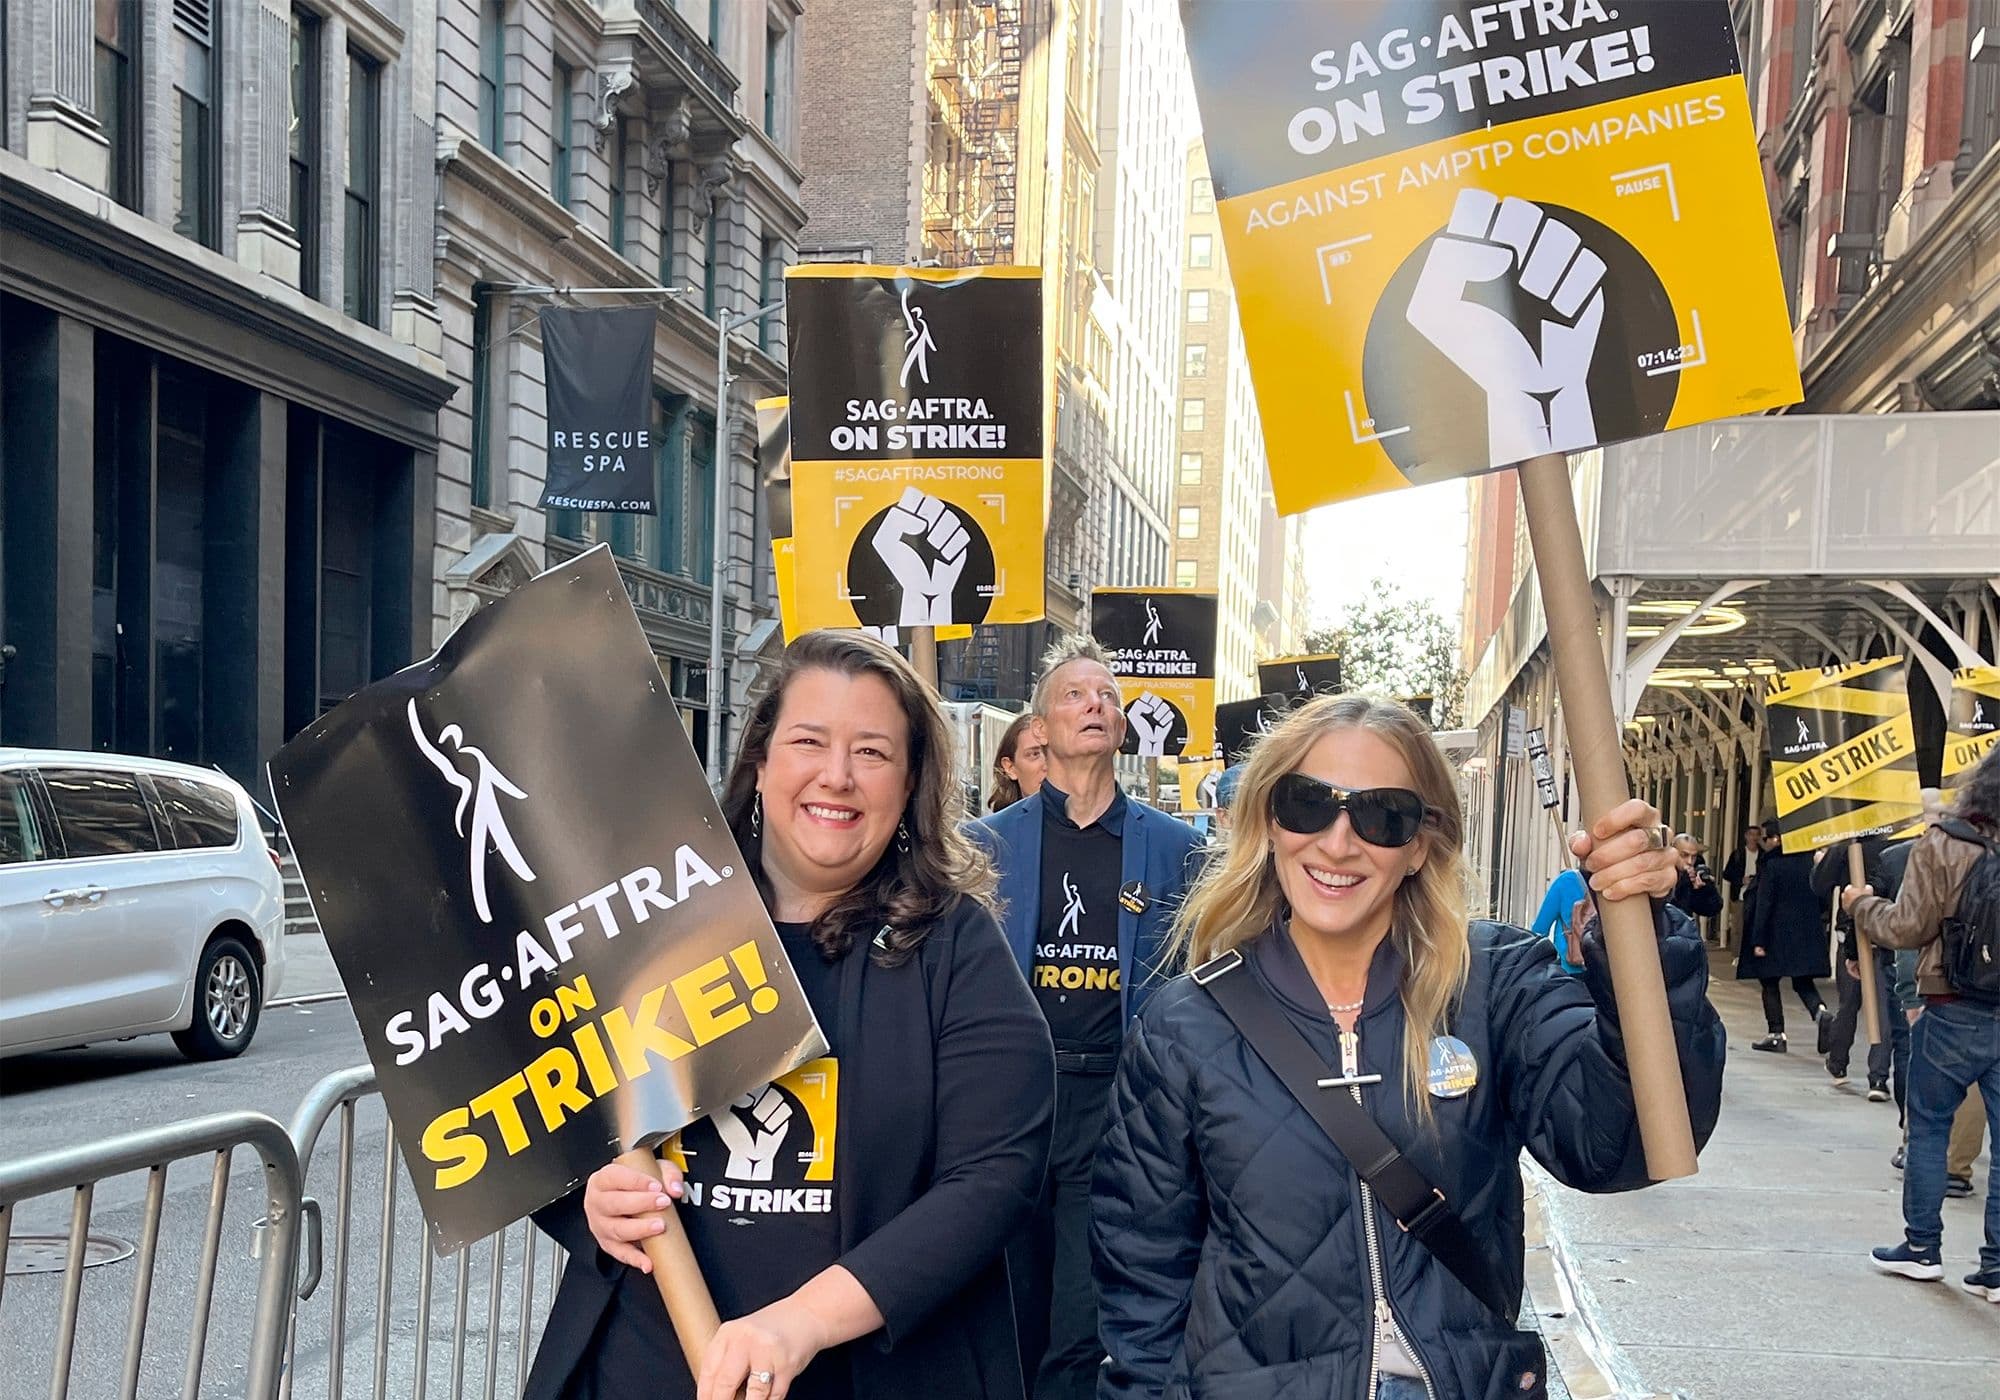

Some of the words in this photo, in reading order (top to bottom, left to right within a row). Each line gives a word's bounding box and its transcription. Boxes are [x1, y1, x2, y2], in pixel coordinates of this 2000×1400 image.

[1287, 89, 1385, 154] ON
[1401, 25, 1655, 124] STRIKE!
[1245, 172, 1387, 234] AGAINST
[1397, 141, 1513, 192] AMPTP
[1523, 95, 1726, 160] COMPANIES
[1615, 176, 1662, 197] PAUSE
[1637, 344, 1695, 368] 07:14:23
[554, 430, 649, 449] RESCUE
[829, 426, 878, 450] ON
[886, 425, 1007, 450] STRIKE!
[583, 455, 626, 472] SPA
[834, 466, 1004, 482] #SAGAFTRASTRONG
[547, 495, 650, 511] RESCUESPA.COM
[1110, 661, 1133, 673] ON
[1136, 662, 1197, 674] STRIKE!
[1785, 768, 1821, 800] ON
[1820, 727, 1904, 783] STRIKE
[1954, 742, 1981, 766] ON
[529, 973, 597, 1040] ON
[421, 939, 781, 1190] STRIKE!
[710, 1184, 833, 1213] STRIKE!
